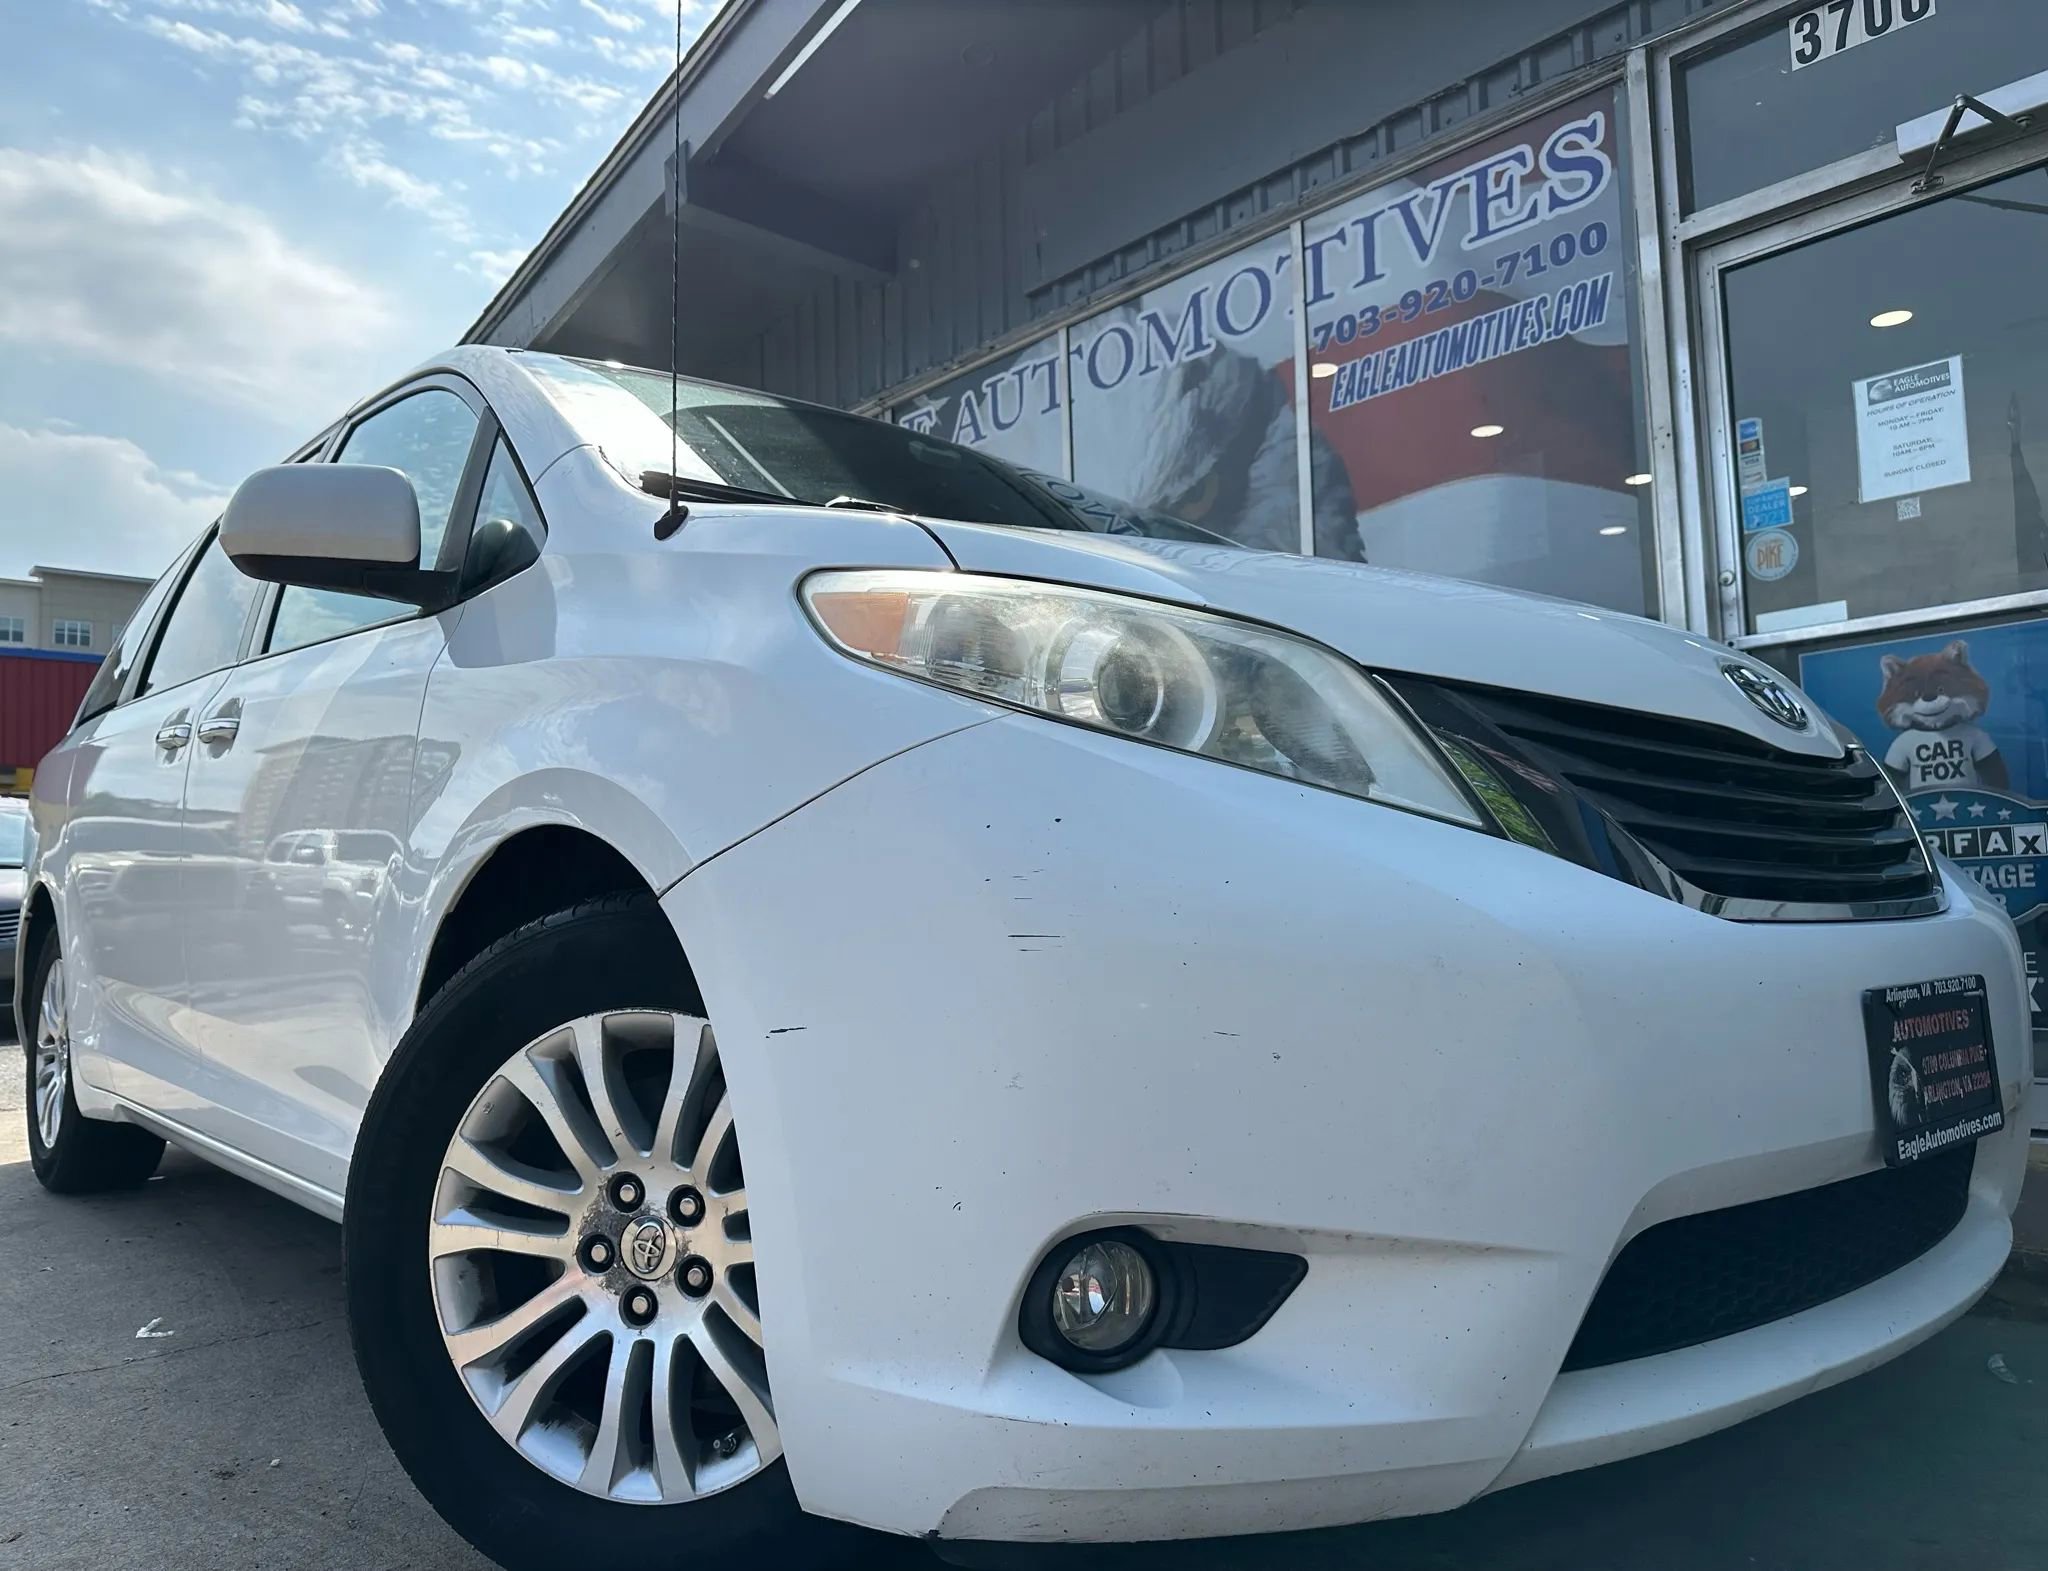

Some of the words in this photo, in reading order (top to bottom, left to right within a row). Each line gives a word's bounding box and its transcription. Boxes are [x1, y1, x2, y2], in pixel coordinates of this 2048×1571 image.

[951, 114, 1608, 445] AUTOMOTIVES
[1313, 221, 1609, 353] 703-920-7100
[1330, 273, 1612, 410] EAGLEAUTOMOTIVES.COM
[1893, 374, 1920, 387] EAGLE
[1894, 372, 1951, 393] AUTOMOTIVES
[1866, 405, 1895, 417] HOURS
[1896, 400, 1907, 410] OF
[1908, 389, 1956, 407] OPERATION
[1878, 415, 1909, 427] MONDAY
[1915, 459, 1947, 471] CLOSED
[1915, 740, 1964, 763] CAR
[1920, 760, 1966, 782] FOX
[1925, 831, 2042, 855] RFAX
[1885, 986, 1921, 1003] Arlington,
[1921, 983, 1932, 997] VA
[1934, 976, 1977, 995] 703.920.7100
[1893, 1008, 1970, 1041] AUTOMOTIVES
[1897, 1110, 2002, 1160] EagleAutomotives.com
